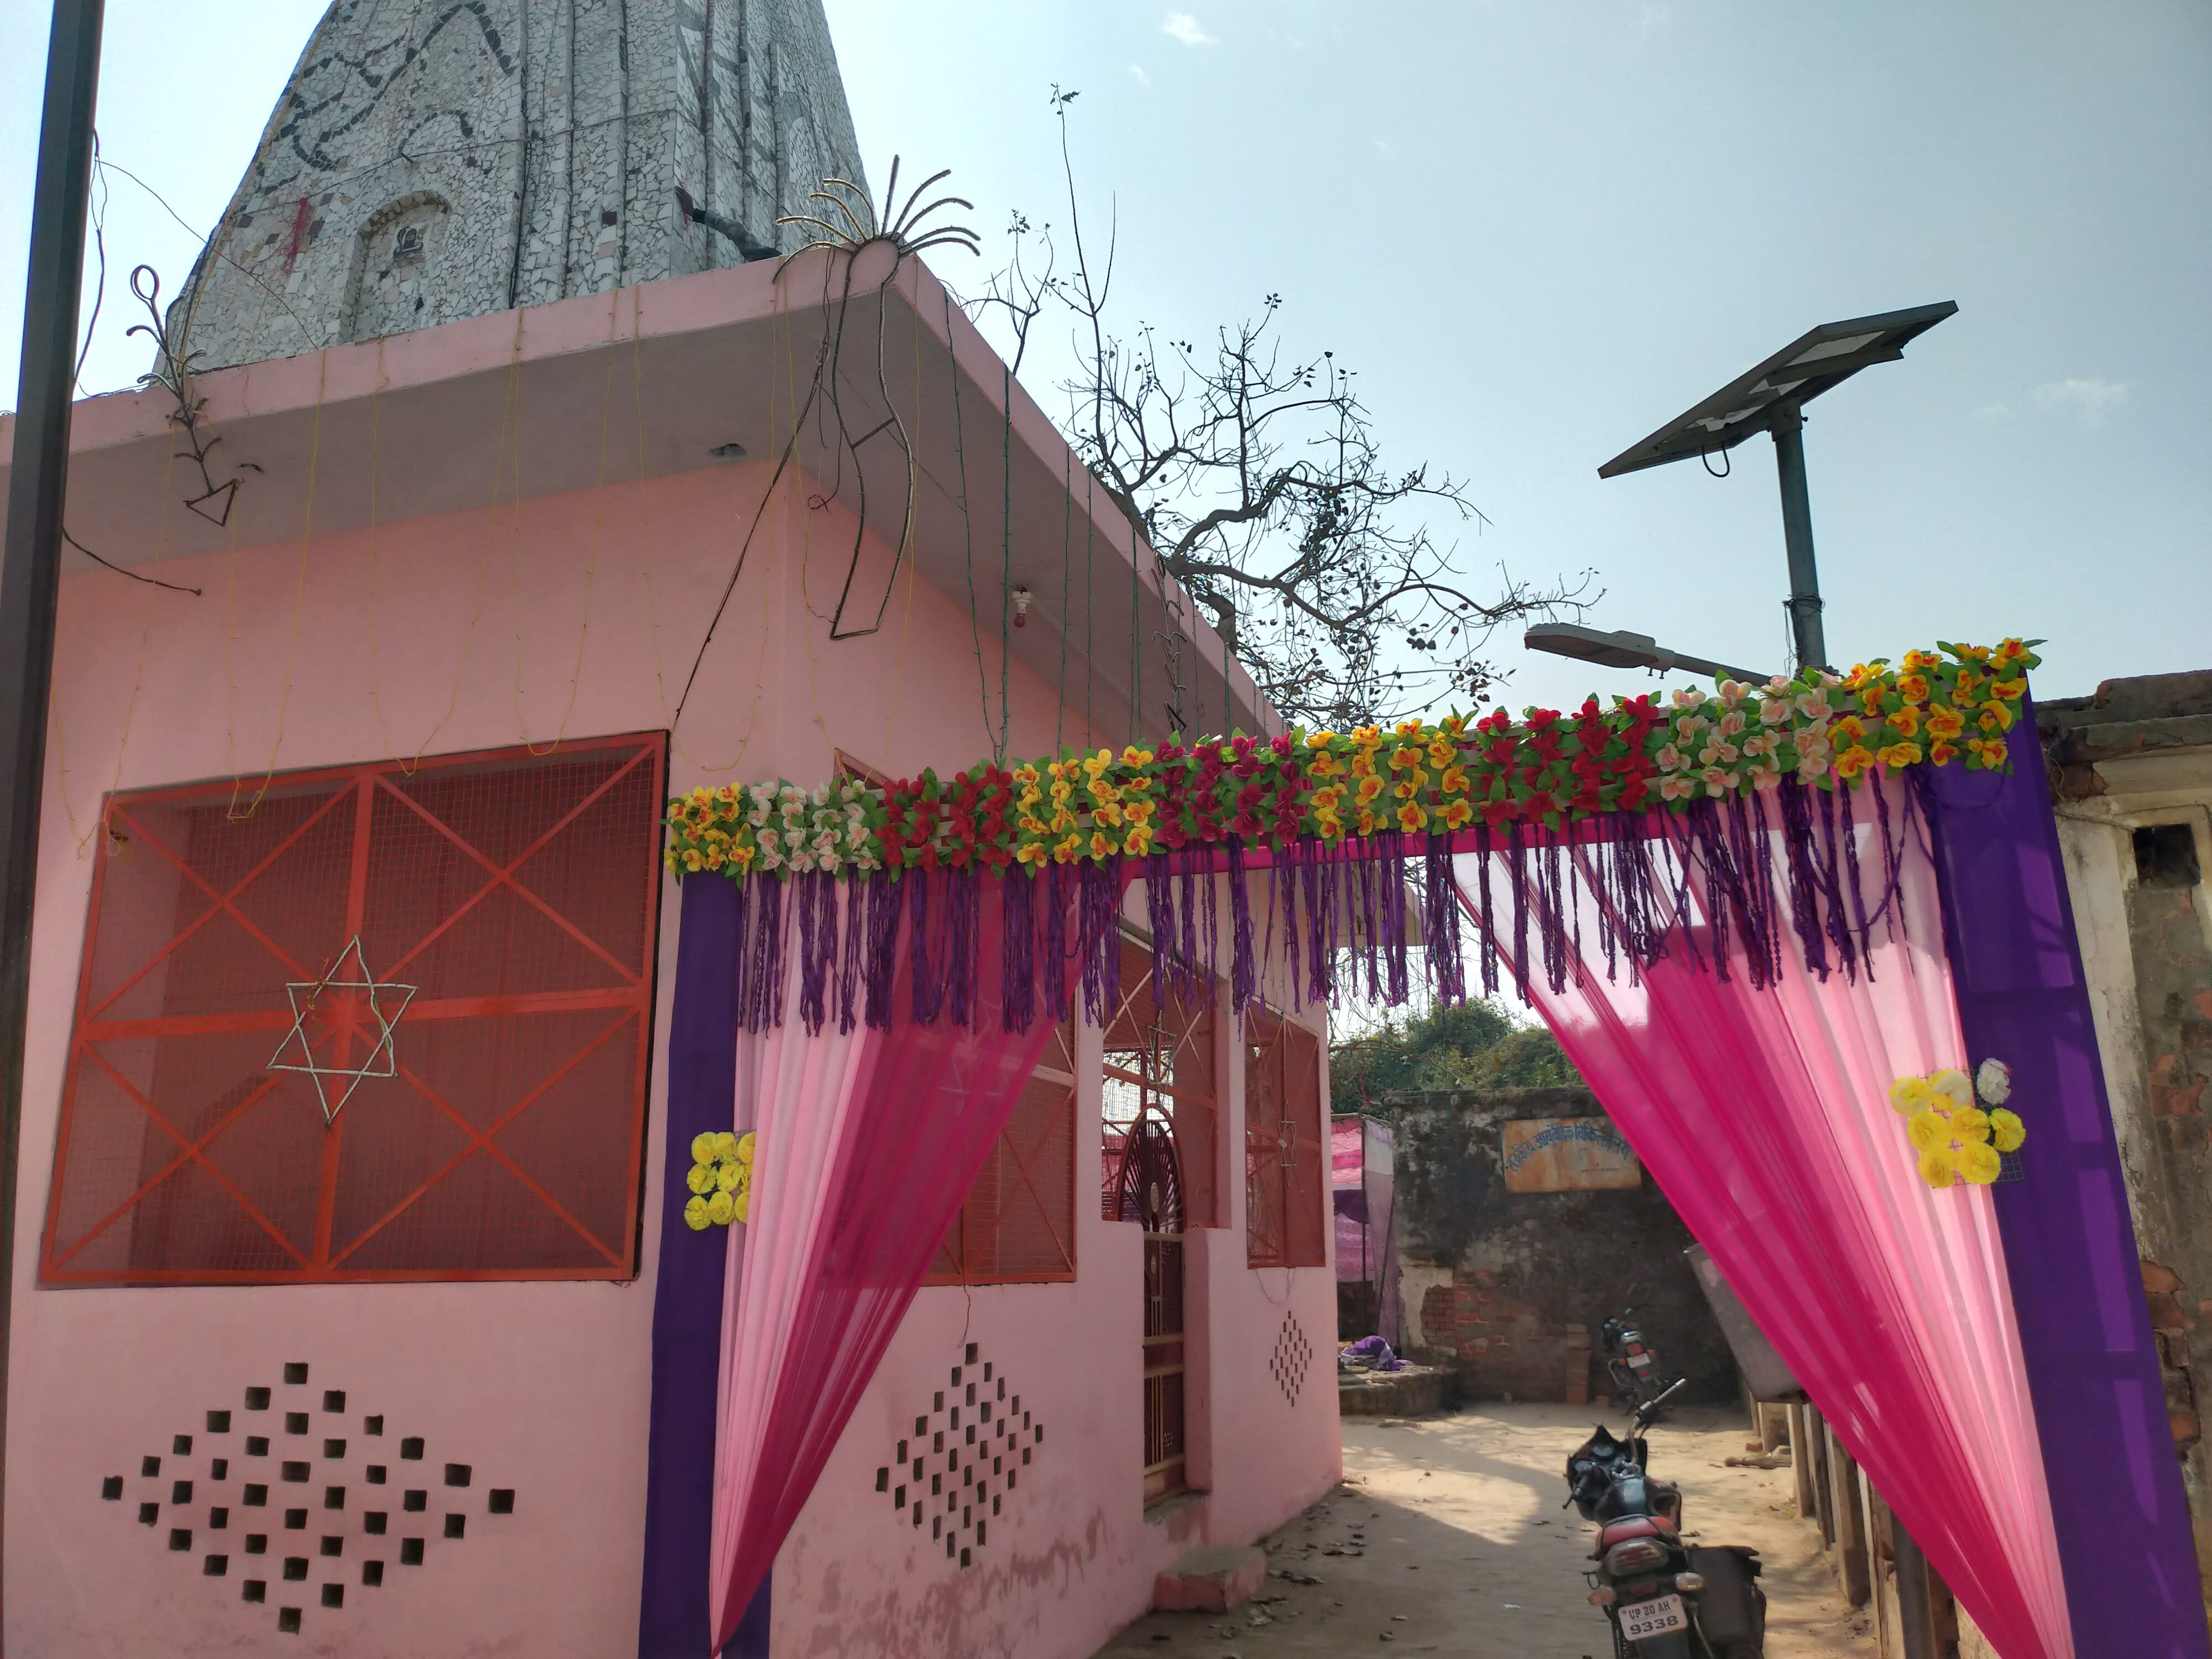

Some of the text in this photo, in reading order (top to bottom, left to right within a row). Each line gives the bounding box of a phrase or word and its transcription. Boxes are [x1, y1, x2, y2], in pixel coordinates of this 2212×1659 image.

[1629, 1601, 1671, 1619] UP 20 AH
[1630, 1615, 1678, 1635] 9338
